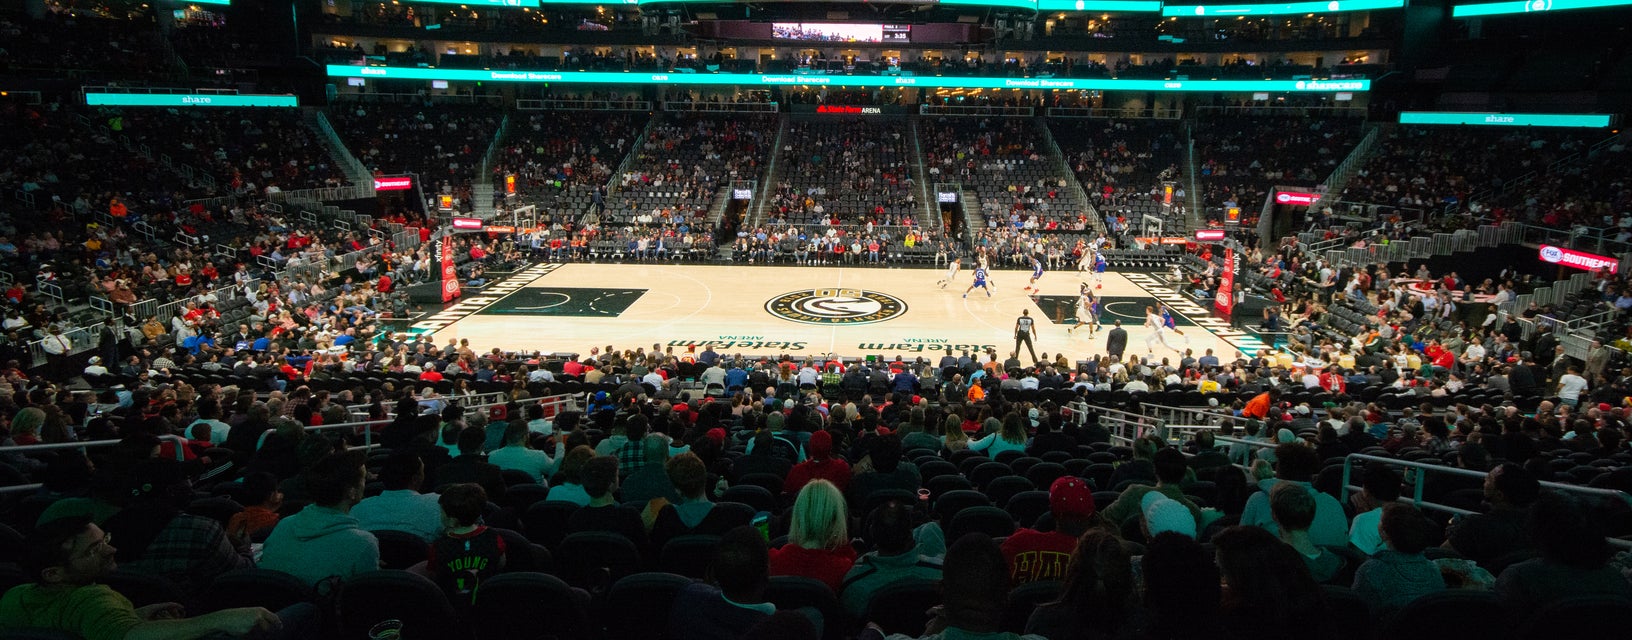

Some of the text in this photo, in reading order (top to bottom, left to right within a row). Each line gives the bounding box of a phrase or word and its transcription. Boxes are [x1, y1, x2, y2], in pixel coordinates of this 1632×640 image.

[762, 75, 830, 84] Download Sharecare
[1006, 79, 1039, 87] Download
[182, 95, 212, 104] share
[1484, 114, 1515, 123] share
[1119, 272, 1211, 314] ATLANTA
[447, 555, 489, 573] YOUNG
